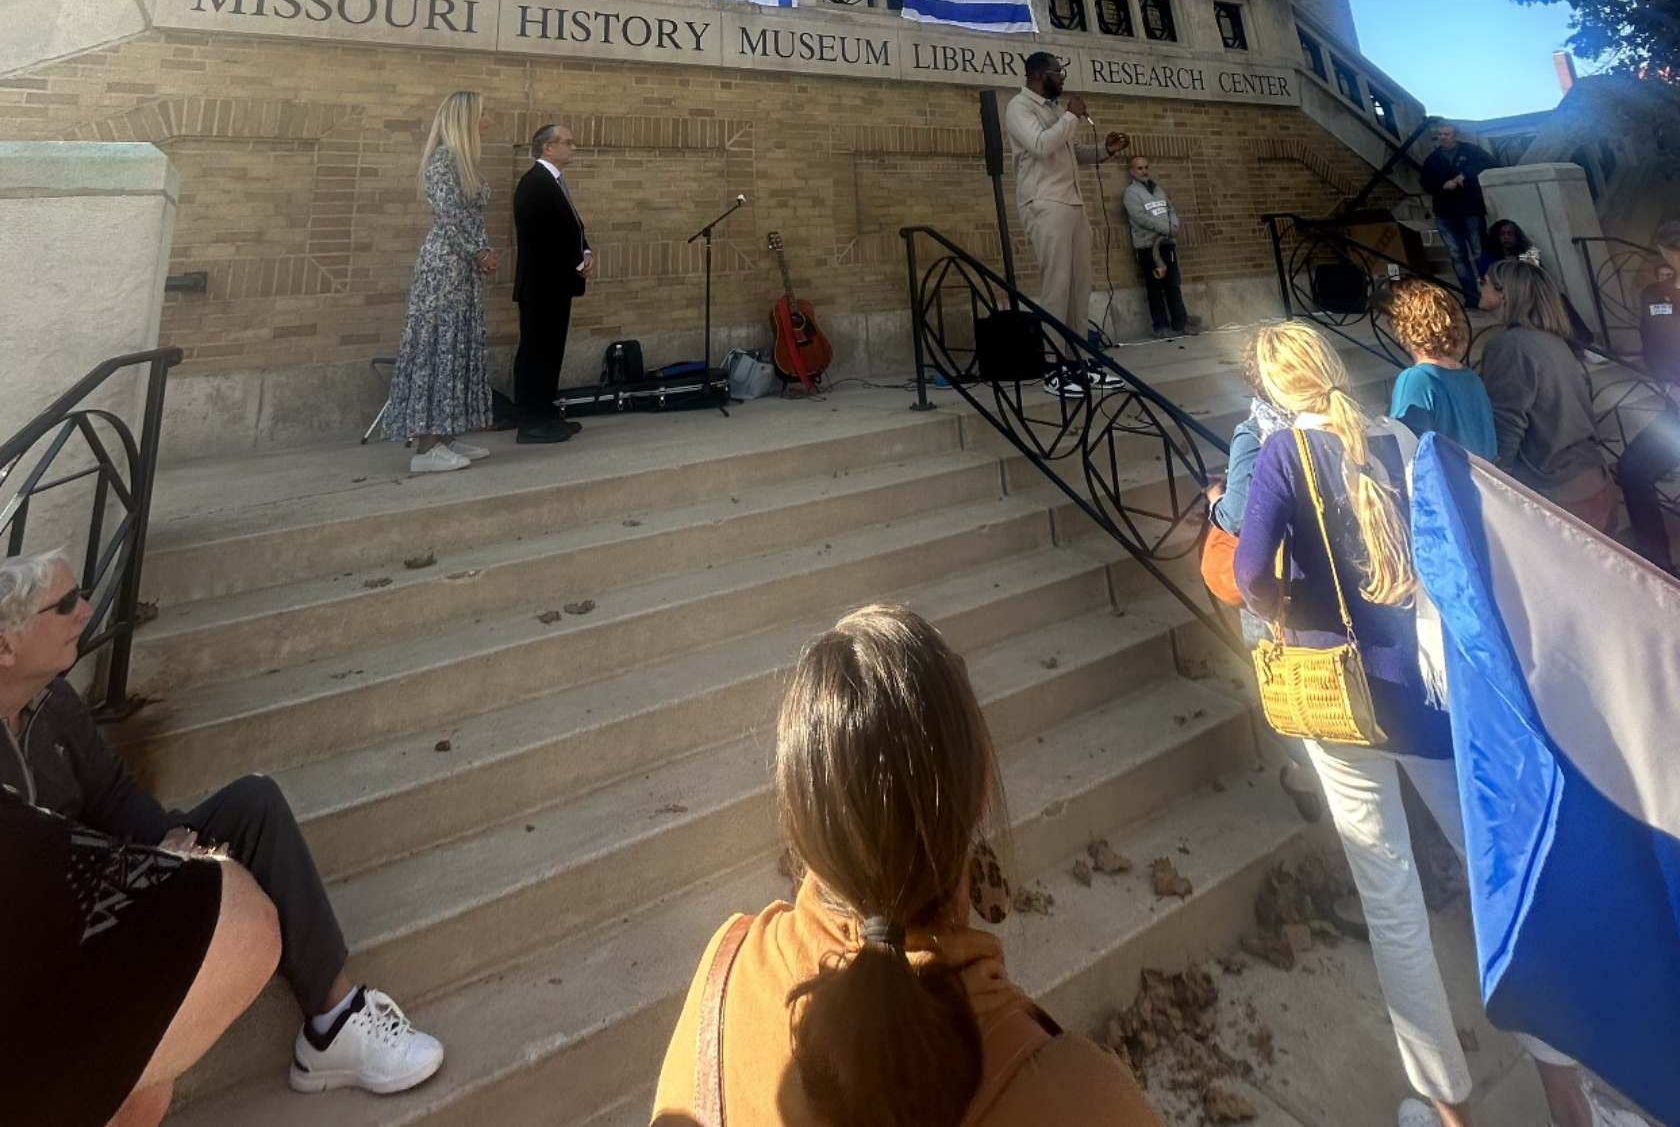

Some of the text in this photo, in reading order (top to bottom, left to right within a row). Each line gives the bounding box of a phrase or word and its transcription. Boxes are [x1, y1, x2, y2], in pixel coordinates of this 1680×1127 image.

[516, 5, 711, 52] HISTORY
[739, 26, 891, 67] MUSEUM
[1090, 60, 1205, 90] RESEARCH
[1218, 71, 1291, 97] CENTER
